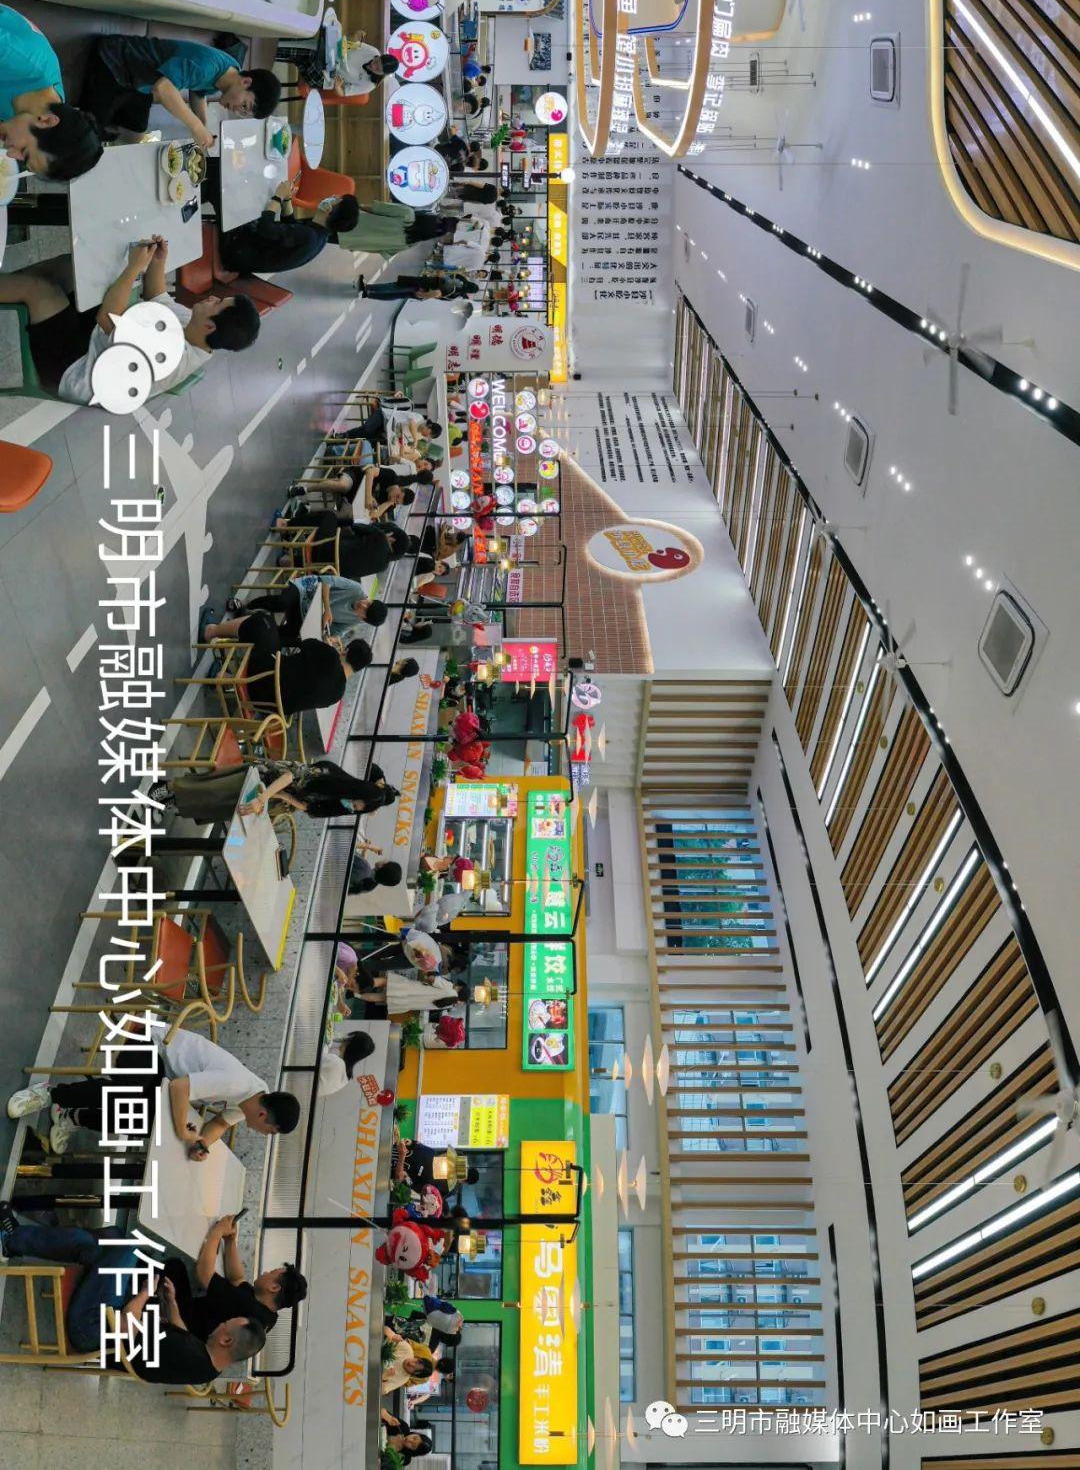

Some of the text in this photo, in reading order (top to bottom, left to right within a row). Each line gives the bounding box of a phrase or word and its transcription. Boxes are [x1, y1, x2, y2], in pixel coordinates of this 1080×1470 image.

[696, 74, 725, 134] 李记锅贴
[448, 346, 460, 370] 明志
[491, 325, 503, 346] 明德
[407, 691, 432, 761] SHAXN
[394, 769, 419, 848] SNACKS
[351, 1109, 378, 1248] SHAXIAN
[343, 1267, 369, 1407] SNACKS
[533, 1383, 550, 1454] 手工米粉
